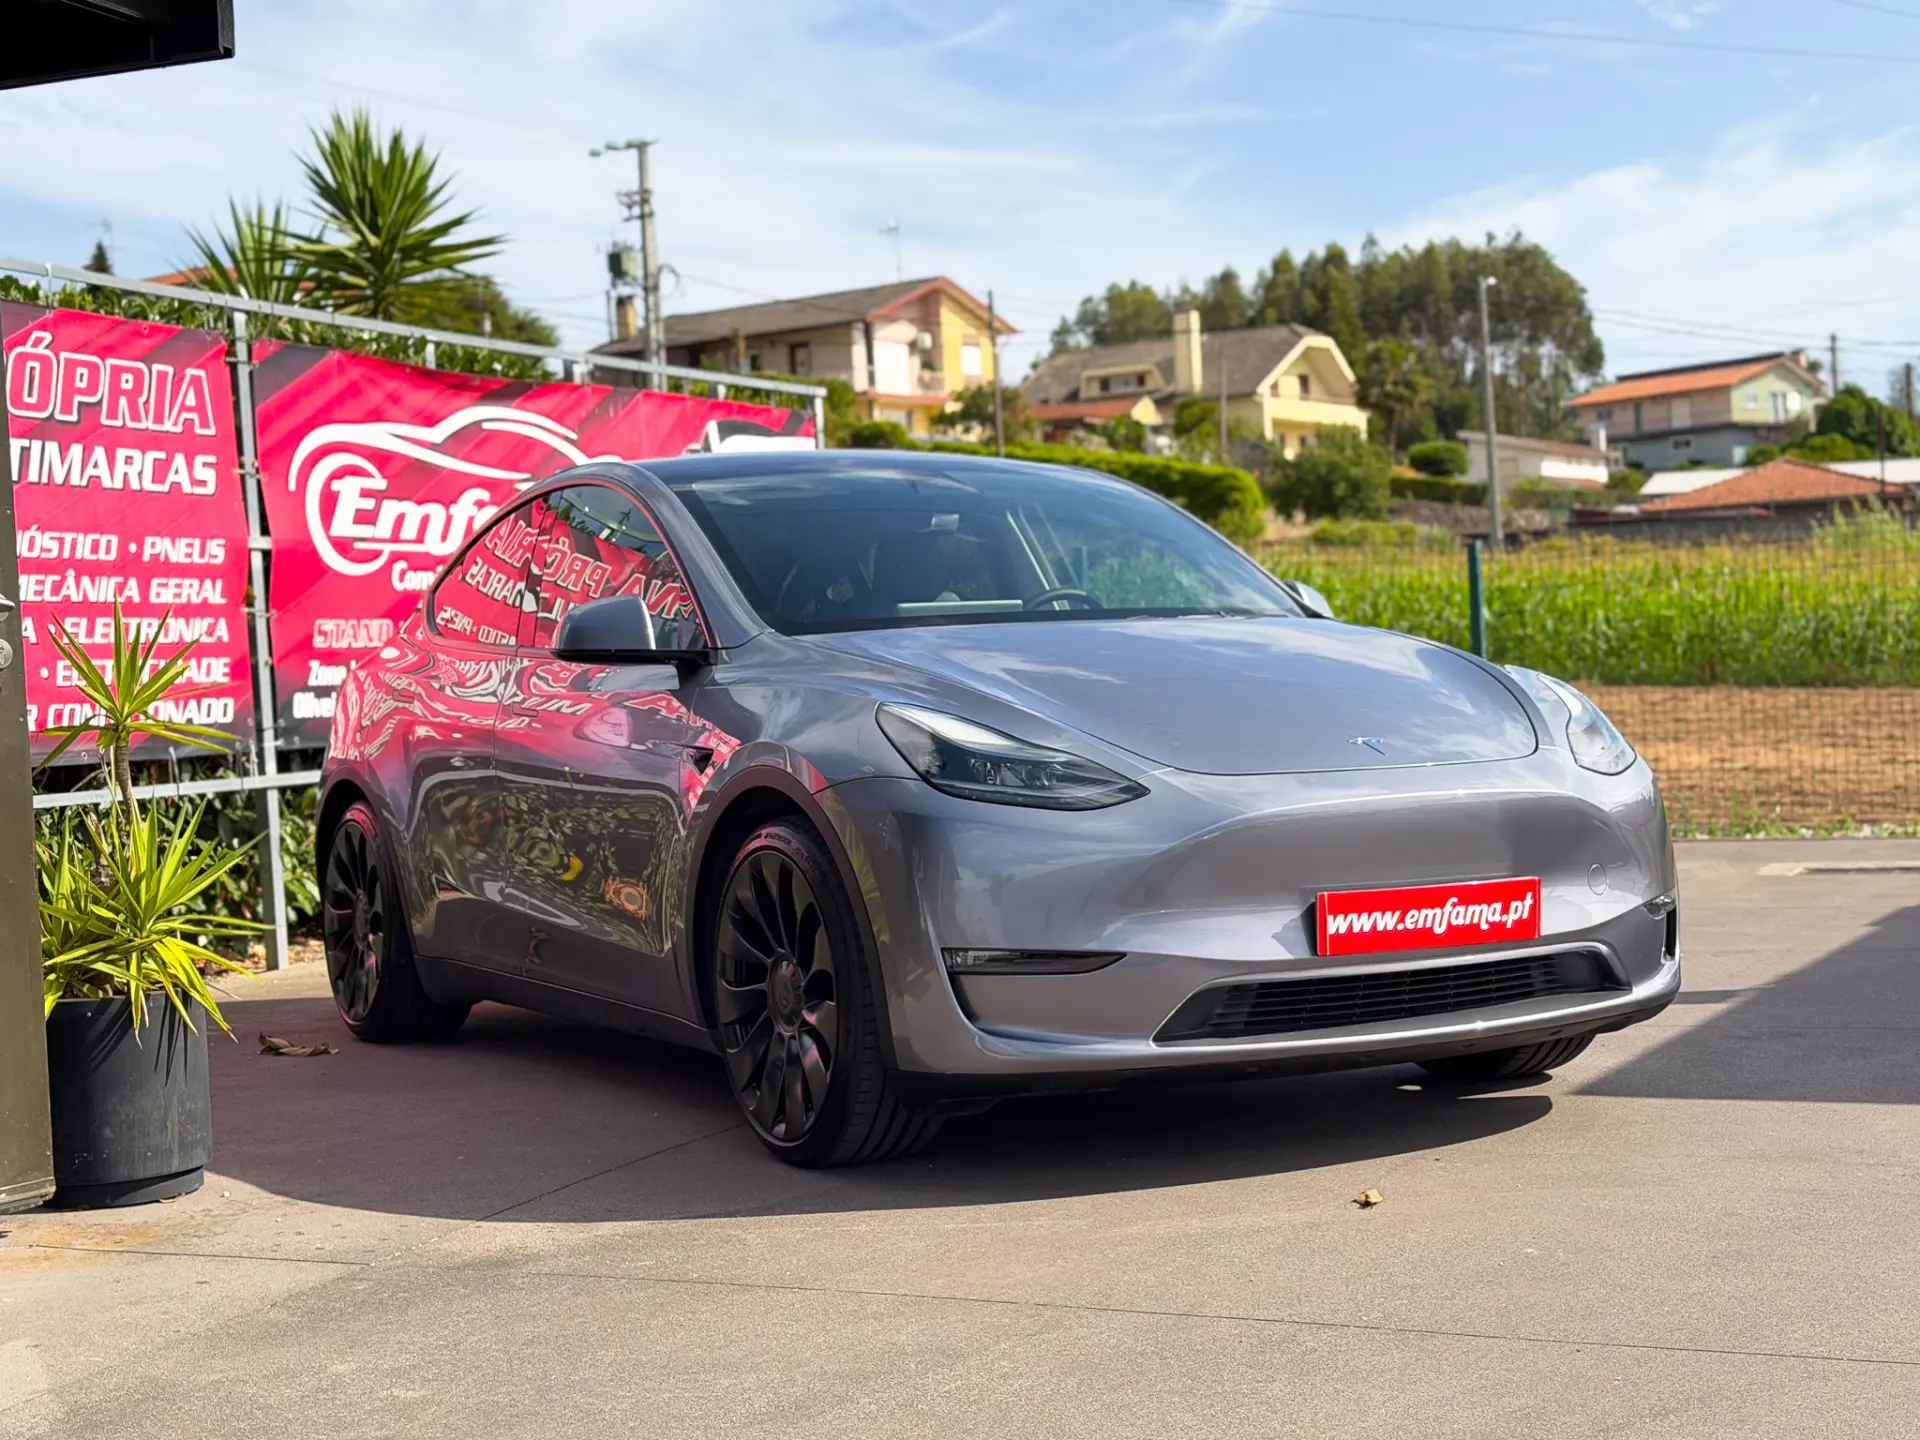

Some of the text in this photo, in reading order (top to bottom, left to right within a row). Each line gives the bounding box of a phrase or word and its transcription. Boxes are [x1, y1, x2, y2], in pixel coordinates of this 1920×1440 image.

[142, 536, 226, 564] PNEUS
[149, 576, 227, 604] GERAL
[391, 559, 444, 592] Com
[313, 619, 393, 648] STAND
[1328, 892, 1533, 935] www.emfama.pt
